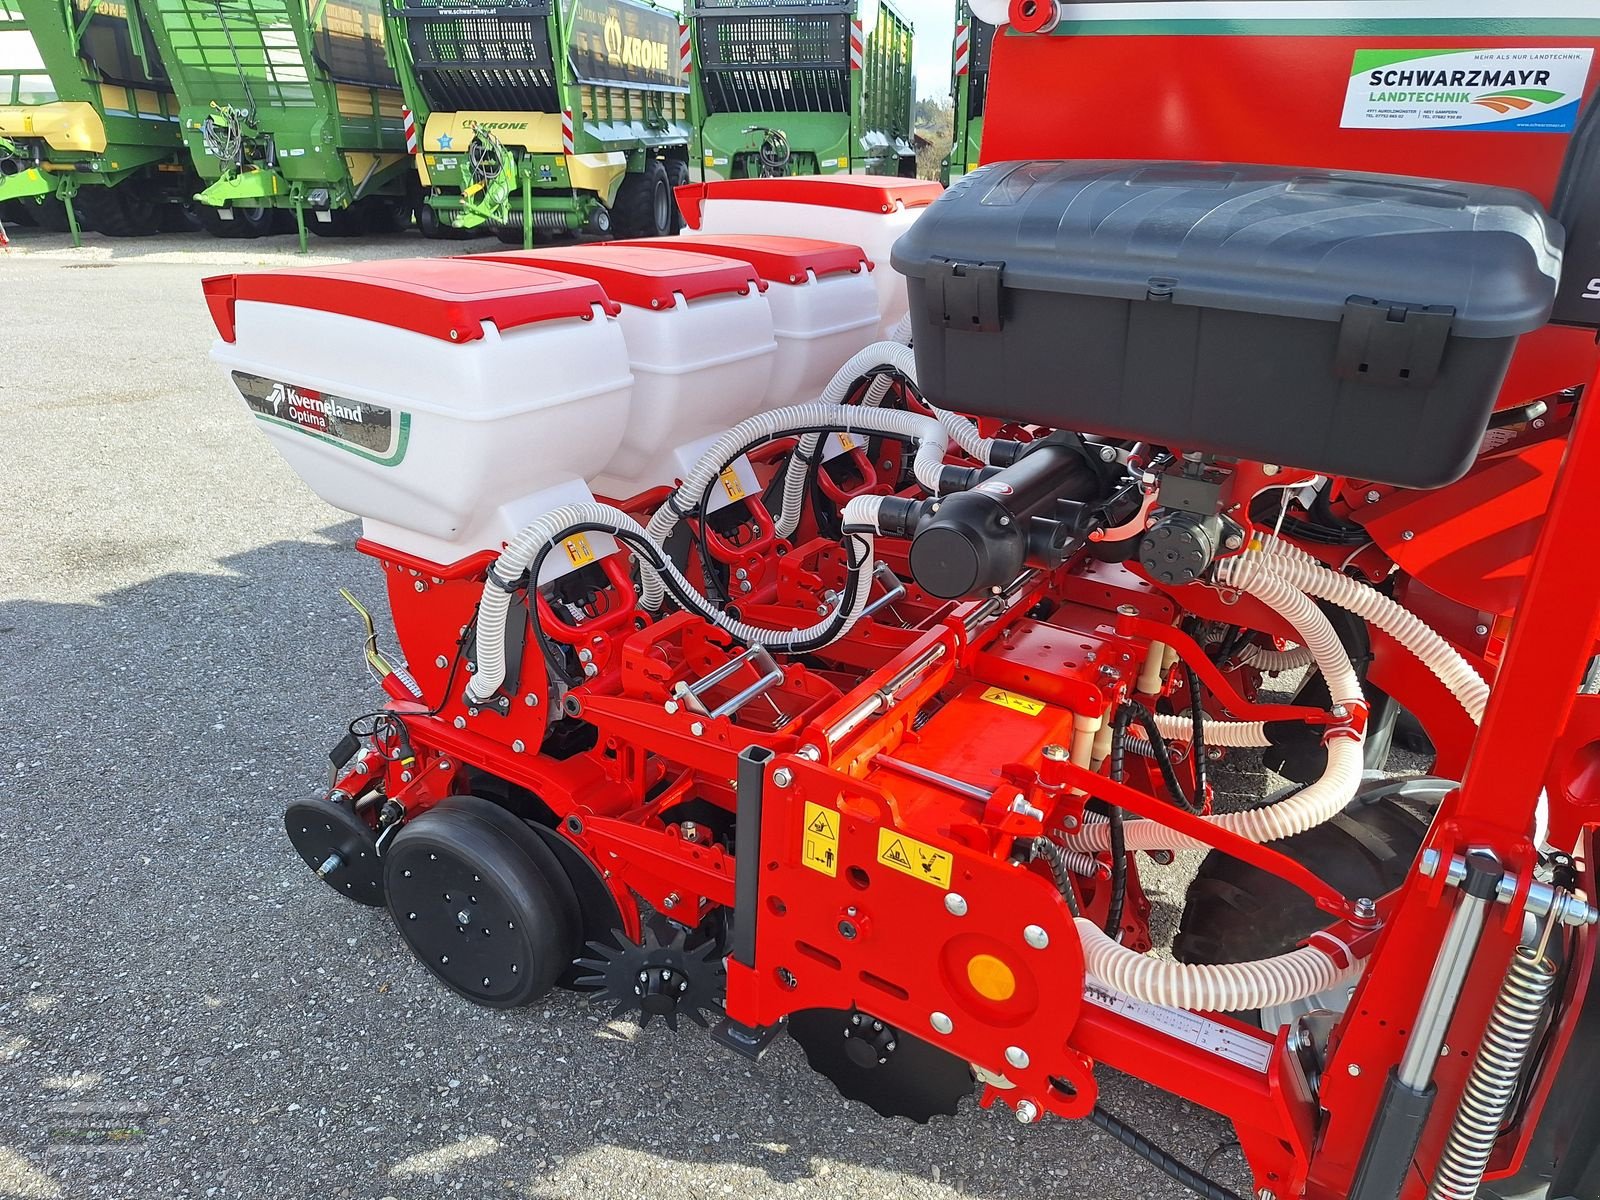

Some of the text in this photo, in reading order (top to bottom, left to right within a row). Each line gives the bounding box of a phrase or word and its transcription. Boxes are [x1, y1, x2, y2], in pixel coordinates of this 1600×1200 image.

[622, 35, 668, 70] KRONE
[1369, 70, 1551, 87] SCHWARZMAYR
[1369, 91, 1471, 103] LANDTECHNIK
[479, 122, 529, 130] KRONE
[286, 388, 363, 423] Kverneland
[289, 406, 326, 427] Optima
